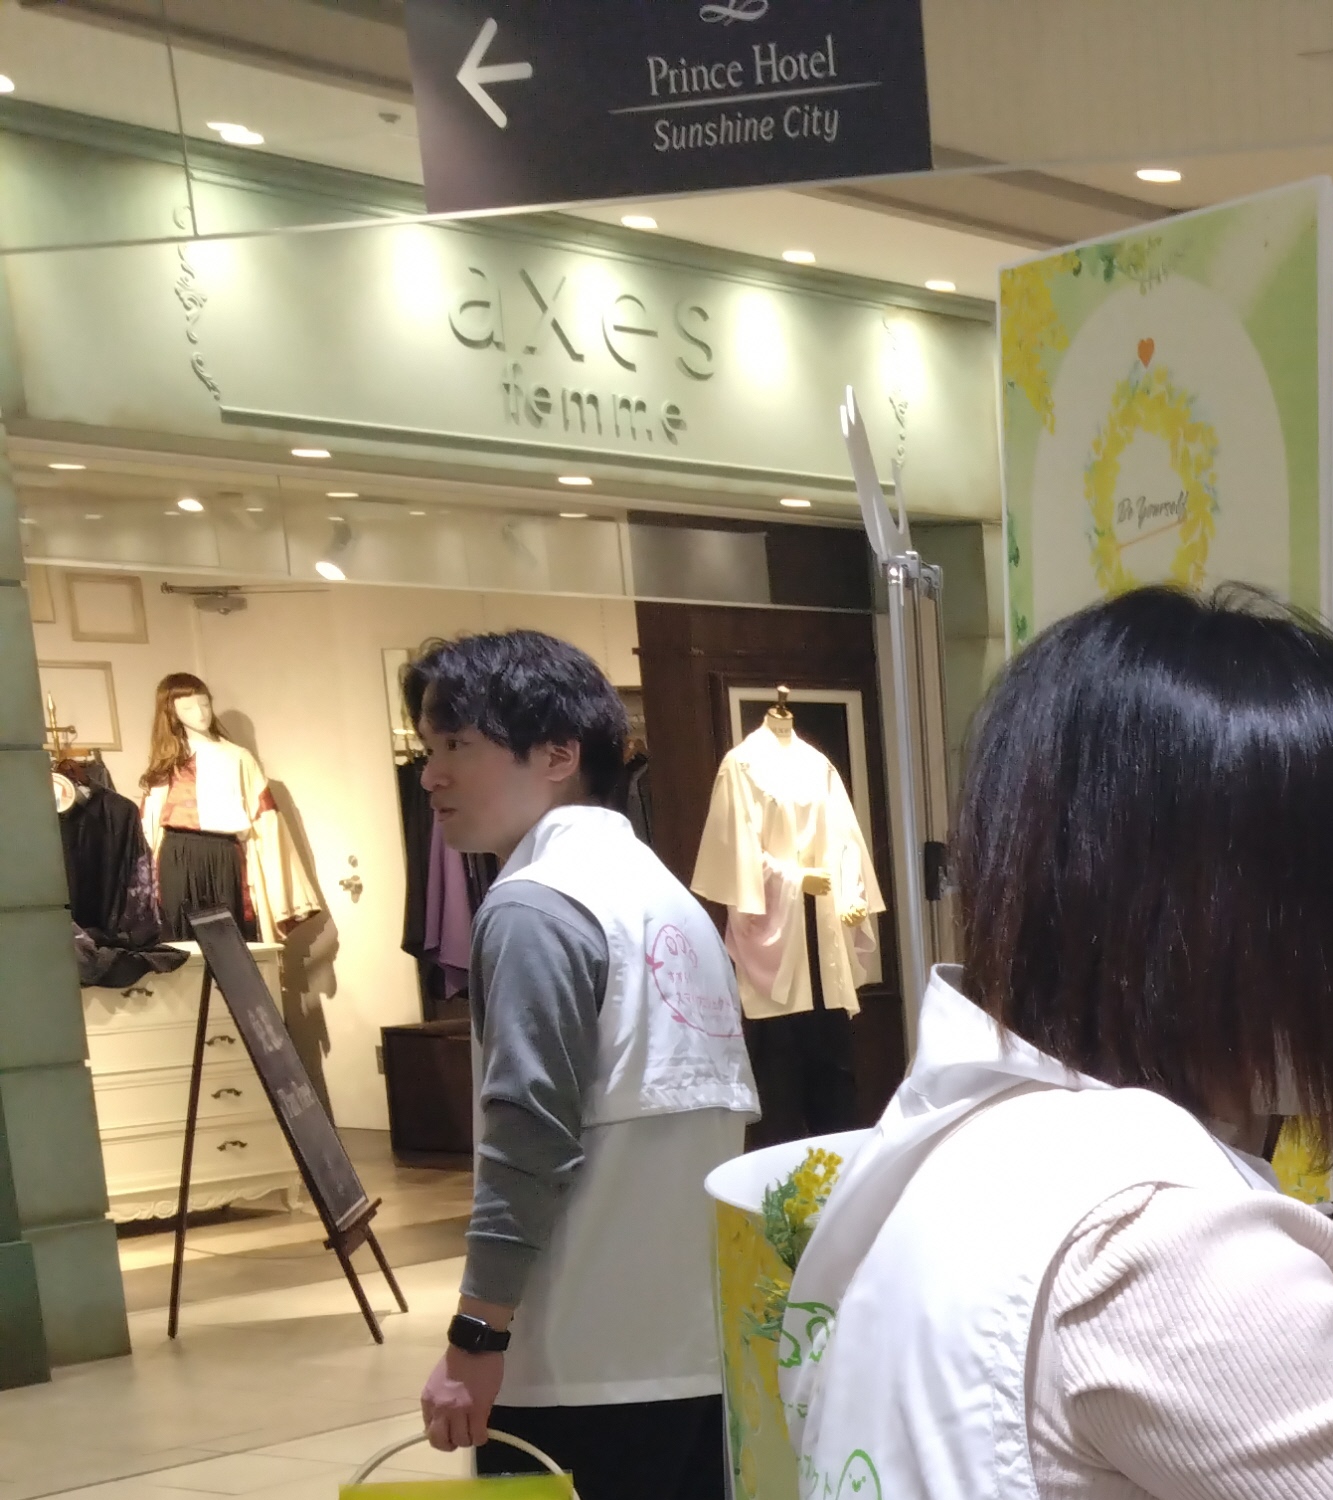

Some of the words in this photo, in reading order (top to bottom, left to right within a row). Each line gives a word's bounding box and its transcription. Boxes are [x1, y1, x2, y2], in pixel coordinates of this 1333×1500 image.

[647, 55, 743, 96] Prince
[752, 34, 838, 85] Hotel
[653, 111, 775, 151] Sunshine
[783, 104, 839, 142] City
[448, 264, 715, 382] axes
[502, 360, 687, 446] femme
